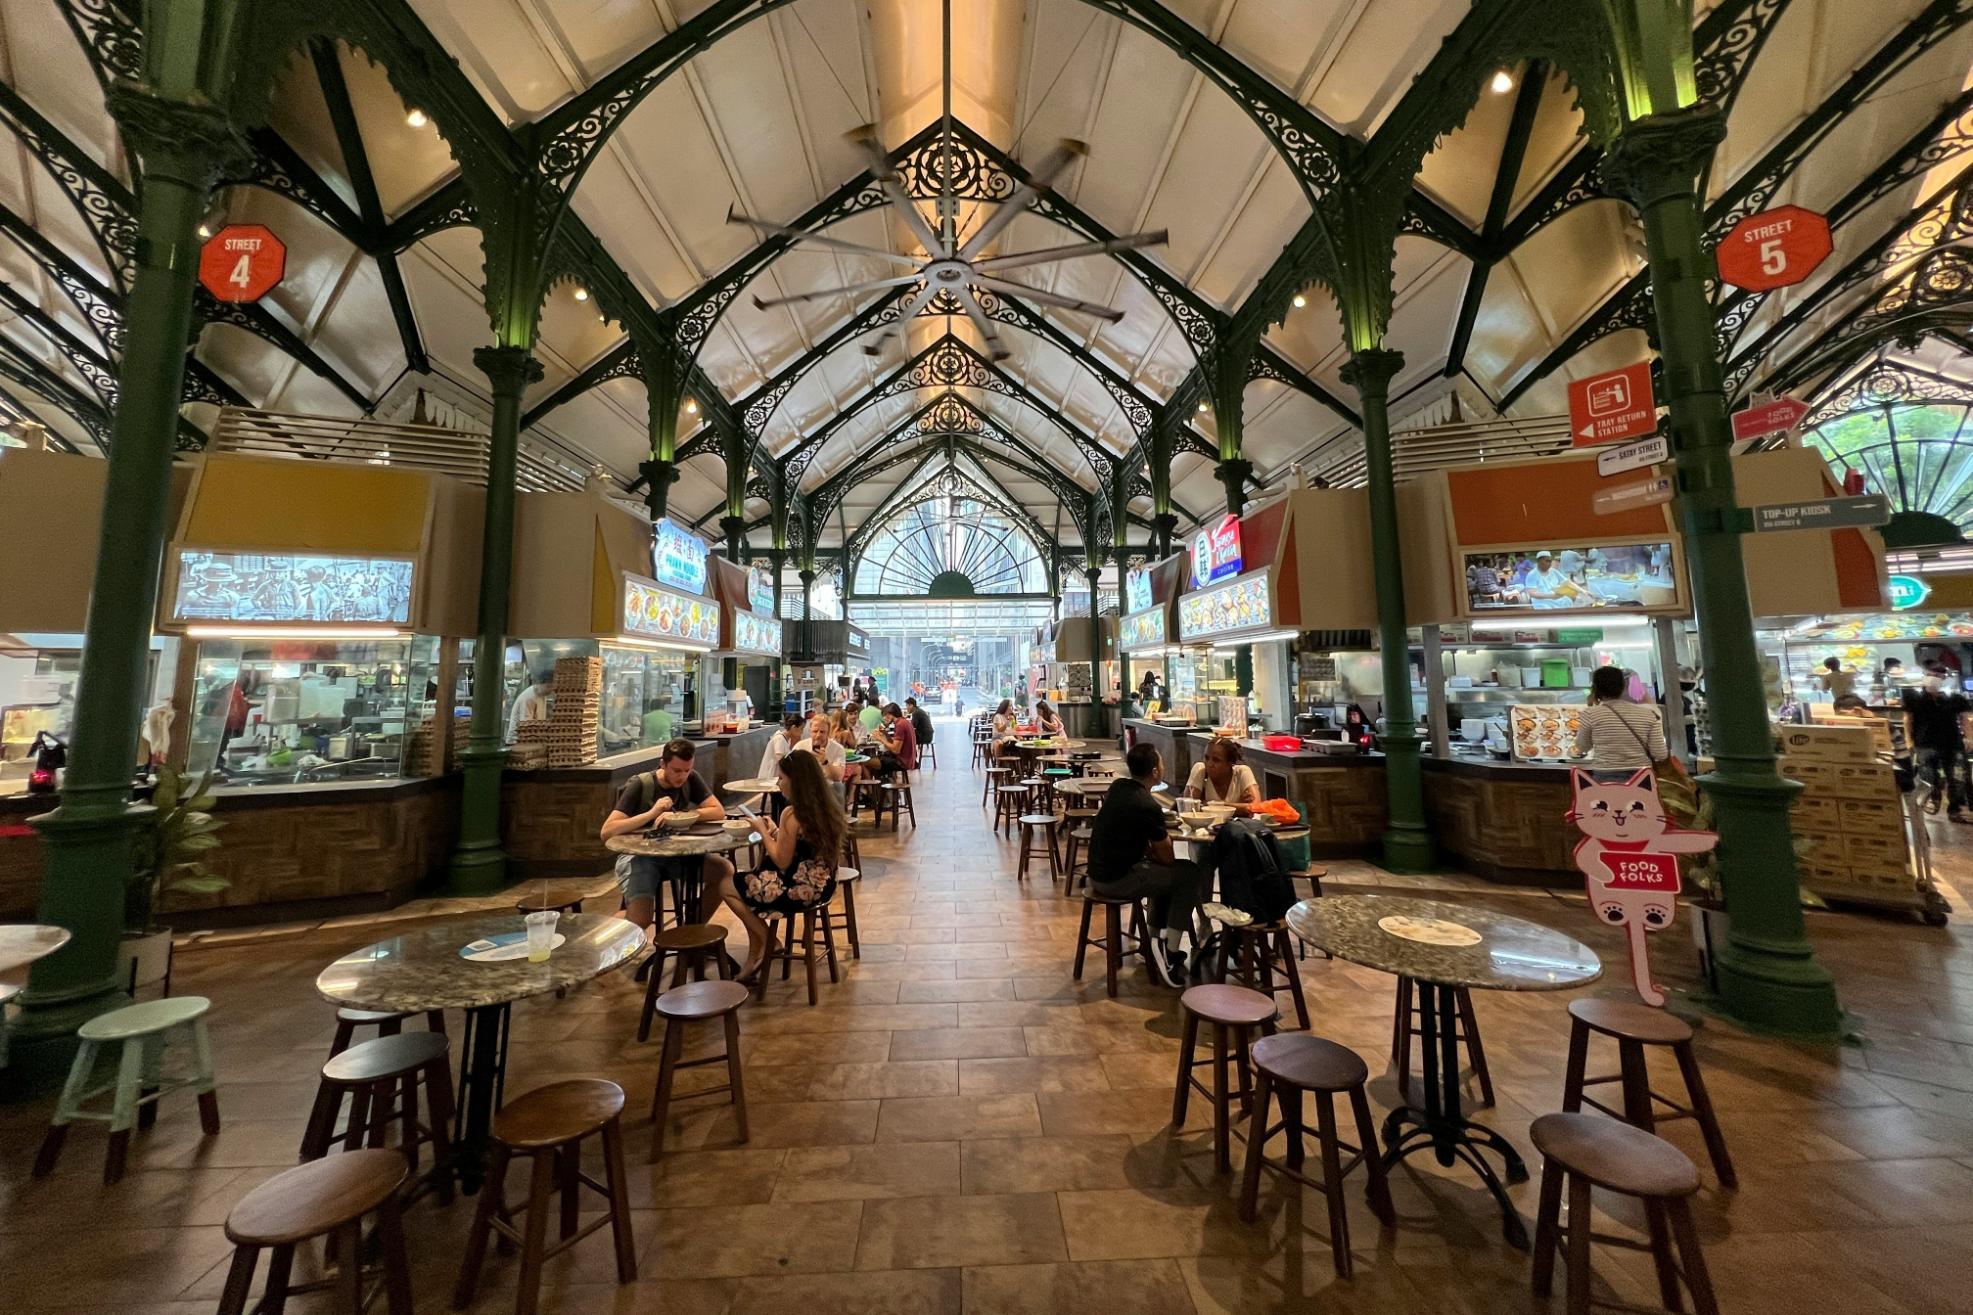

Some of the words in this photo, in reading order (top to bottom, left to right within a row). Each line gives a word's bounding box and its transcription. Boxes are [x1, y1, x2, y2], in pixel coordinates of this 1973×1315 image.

[1743, 219, 1793, 243] STREET
[224, 238, 262, 251] STREET
[1760, 239, 1787, 275] 5
[229, 254, 250, 288] 4
[1596, 417, 1615, 429] TRAY
[1617, 410, 1647, 425] RETURN
[1597, 424, 1629, 438] STATION
[1638, 441, 1662, 455] STREET
[1762, 507, 1798, 519] TOP-UP
[1801, 505, 1832, 517] KIOSK
[1619, 861, 1659, 873] FOOD
[1619, 872, 1664, 884] FOLKS
